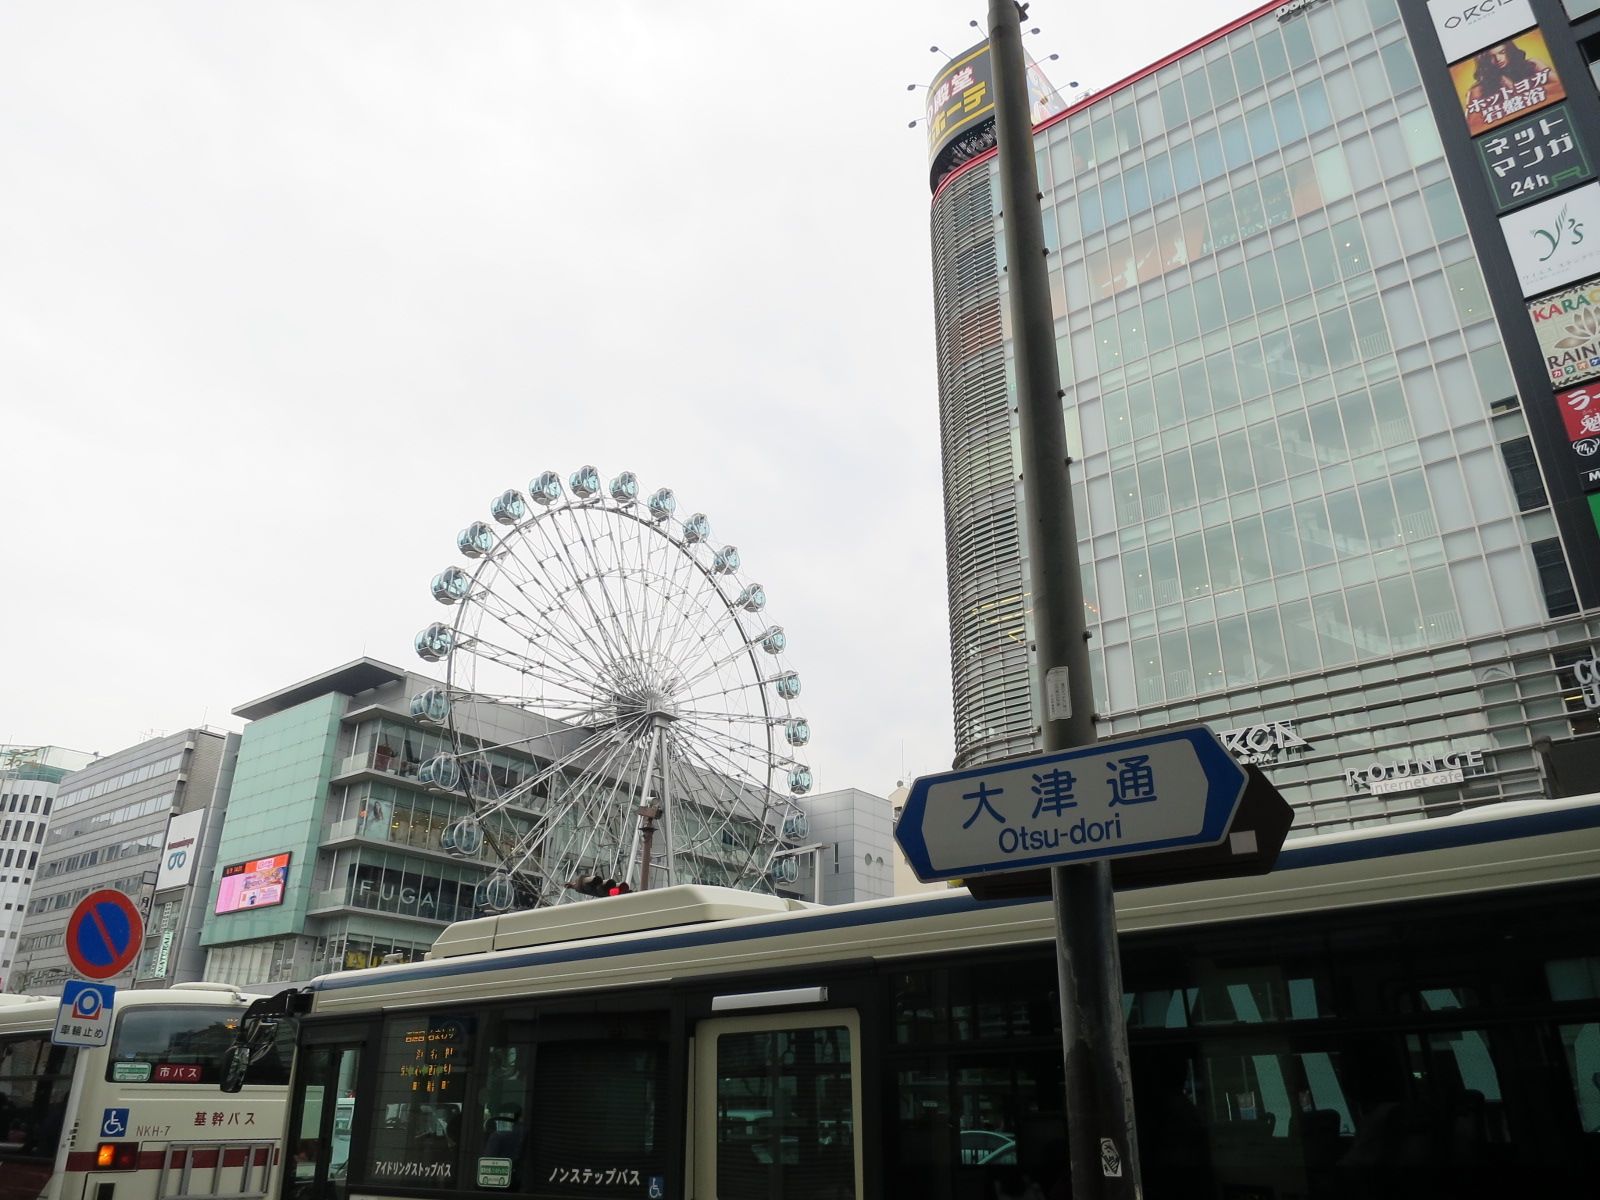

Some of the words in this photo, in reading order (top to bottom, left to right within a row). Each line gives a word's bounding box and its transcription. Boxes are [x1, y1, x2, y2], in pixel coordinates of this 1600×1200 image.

[1444, 0, 1514, 29] ORC
[1467, 68, 1552, 114] ホットヨガ
[1481, 87, 1547, 125] 岩盤浴
[1484, 118, 1564, 155] ネット
[1490, 132, 1575, 178] マンガ
[1510, 173, 1550, 198] 24h
[1344, 750, 1485, 787] ROUNGE
[962, 754, 1158, 830] 大津通
[1371, 777, 1429, 795] internet
[1431, 771, 1462, 786] cafe
[998, 813, 1123, 854] Otsu-dori
[360, 880, 434, 908] FUGA
[60, 1024, 104, 1039] 車輪止め
[159, 1066, 199, 1078] 市バス
[136, 1125, 171, 1137] NKH-7
[194, 1111, 256, 1127] 基幹バス
[374, 1160, 452, 1178] アイドリングストップバス
[549, 1167, 641, 1186] ノンステップバス
